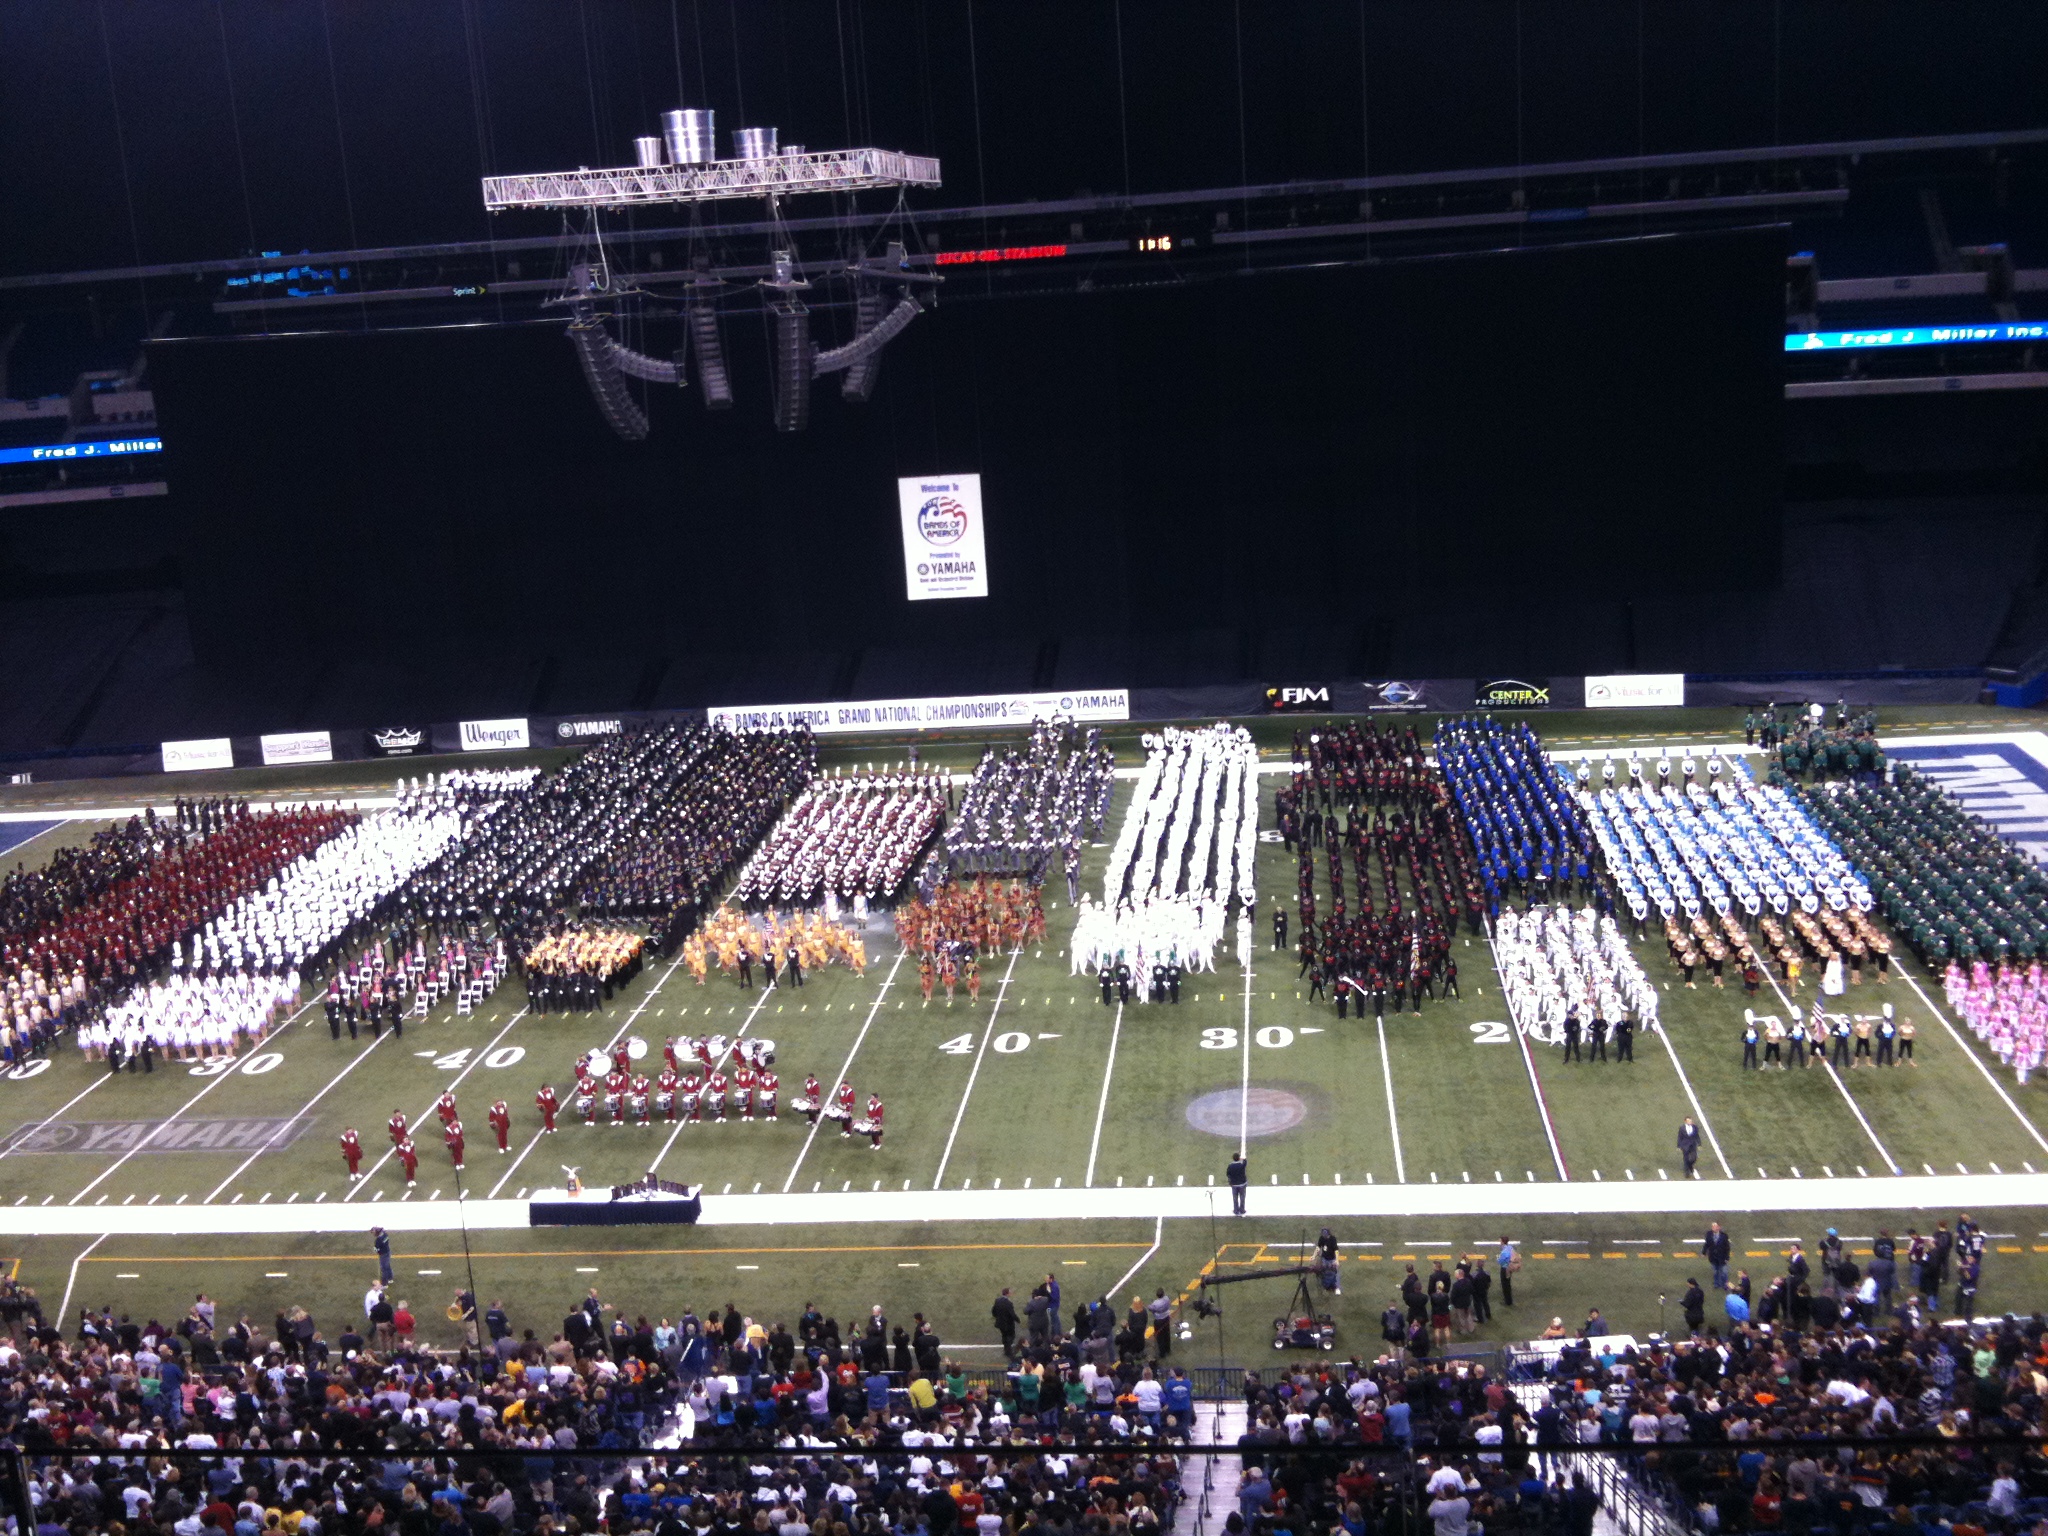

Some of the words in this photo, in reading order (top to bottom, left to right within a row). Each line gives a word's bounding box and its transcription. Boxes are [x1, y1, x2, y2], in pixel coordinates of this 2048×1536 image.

[1839, 331, 1894, 346] Fred
[1932, 328, 1998, 341] Miller
[33, 446, 77, 459] Fred
[84, 445, 101, 455] J.
[921, 484, 950, 493] Welcome
[924, 521, 948, 530] BANDS
[950, 520, 960, 529] OF
[926, 530, 960, 538] AMERICA
[931, 560, 977, 575] YAMAHA
[1075, 694, 1126, 709] YAMAHA
[1282, 687, 1330, 704] FJM
[1475, 698, 1550, 706] PRODUCTIONS
[735, 711, 768, 728] BANDS
[772, 711, 785, 727] OF
[787, 710, 831, 727] AMERICA
[838, 708, 871, 724] GRAND
[875, 706, 922, 723] NATIONAL
[926, 701, 1008, 722] CHAMPIONSHIPS
[465, 723, 523, 747] Wenger
[573, 720, 624, 736] YAMAHA
[938, 1032, 1031, 1054] 40
[1200, 1026, 1295, 1049] 30
[432, 1046, 526, 1069] 40
[80, 1121, 295, 1150] YAMAHA
